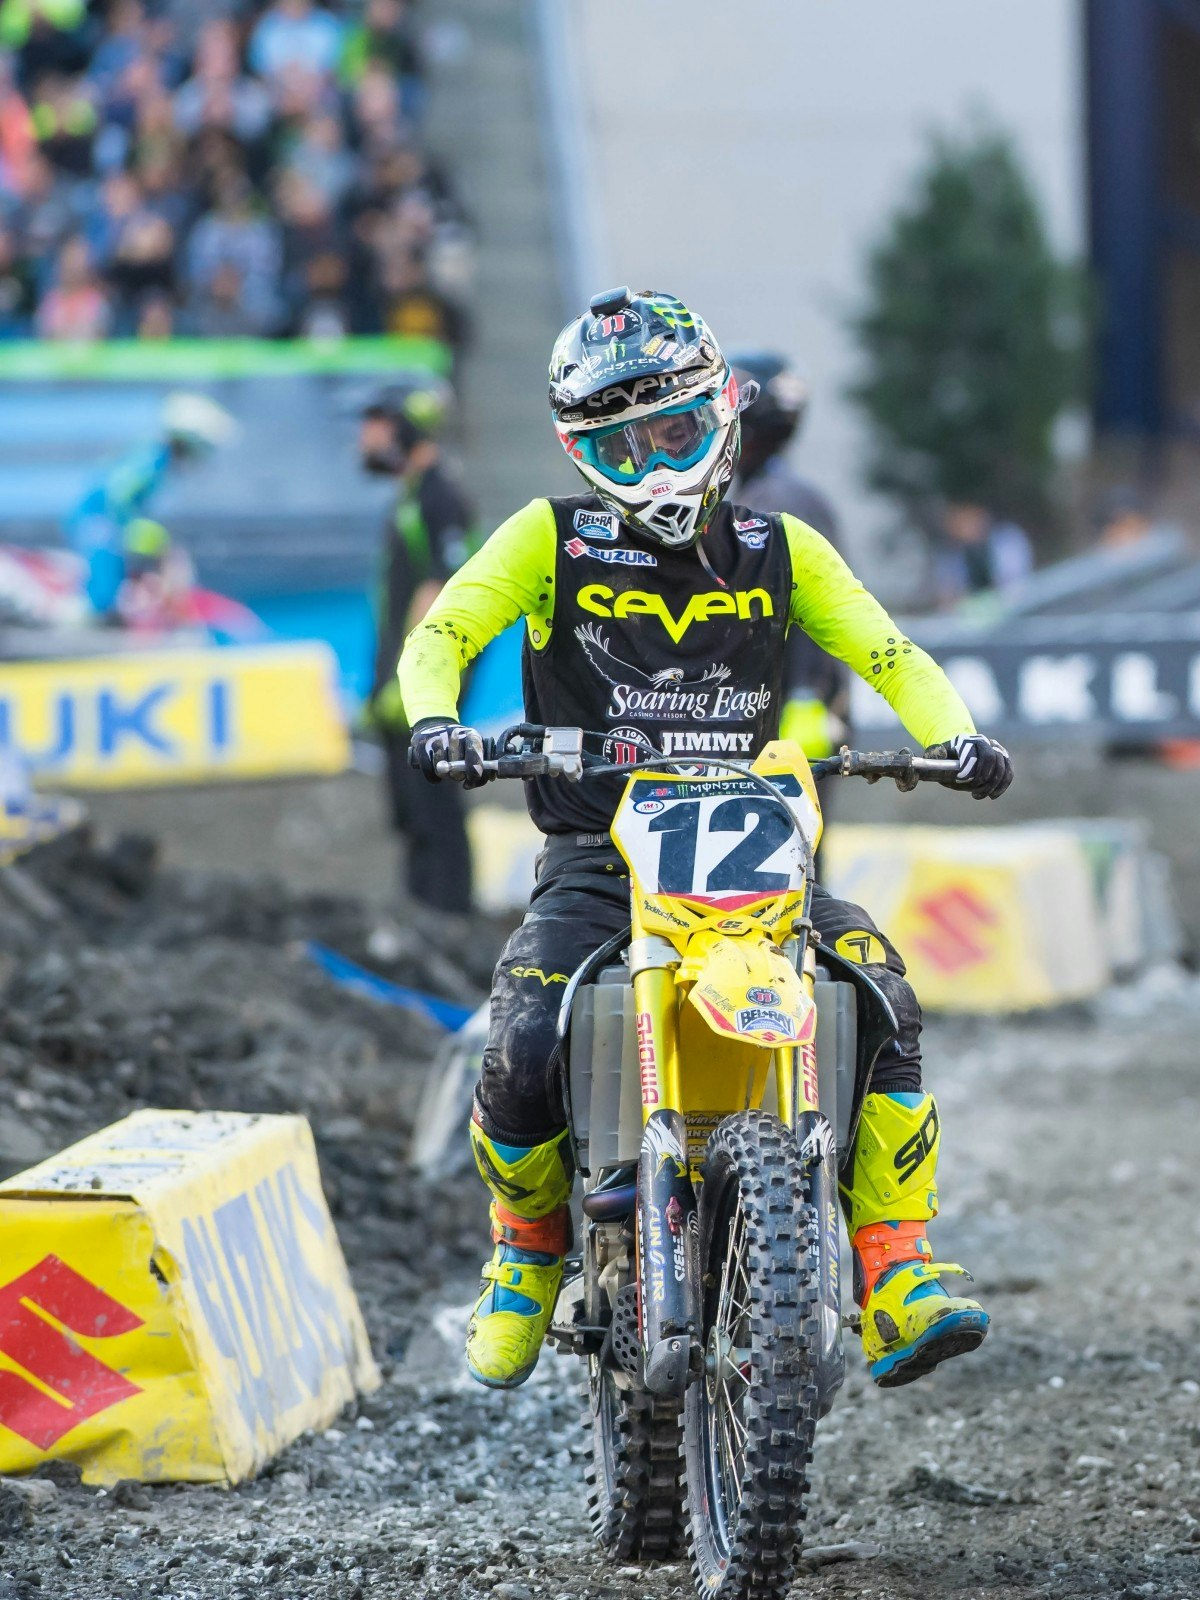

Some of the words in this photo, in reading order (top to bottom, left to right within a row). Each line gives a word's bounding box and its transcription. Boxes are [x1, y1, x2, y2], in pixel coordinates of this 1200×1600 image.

[590, 357, 661, 380] ONSTER
[651, 484, 672, 497] BELL
[587, 546, 656, 565] SUZUKI
[608, 683, 709, 719] Soaring
[709, 683, 771, 719] Eagle
[662, 731, 754, 756] JIMMY
[647, 796, 796, 894] 12
[636, 1012, 659, 1105] SHOWA
[672, 1225, 686, 1282] ERBIS
